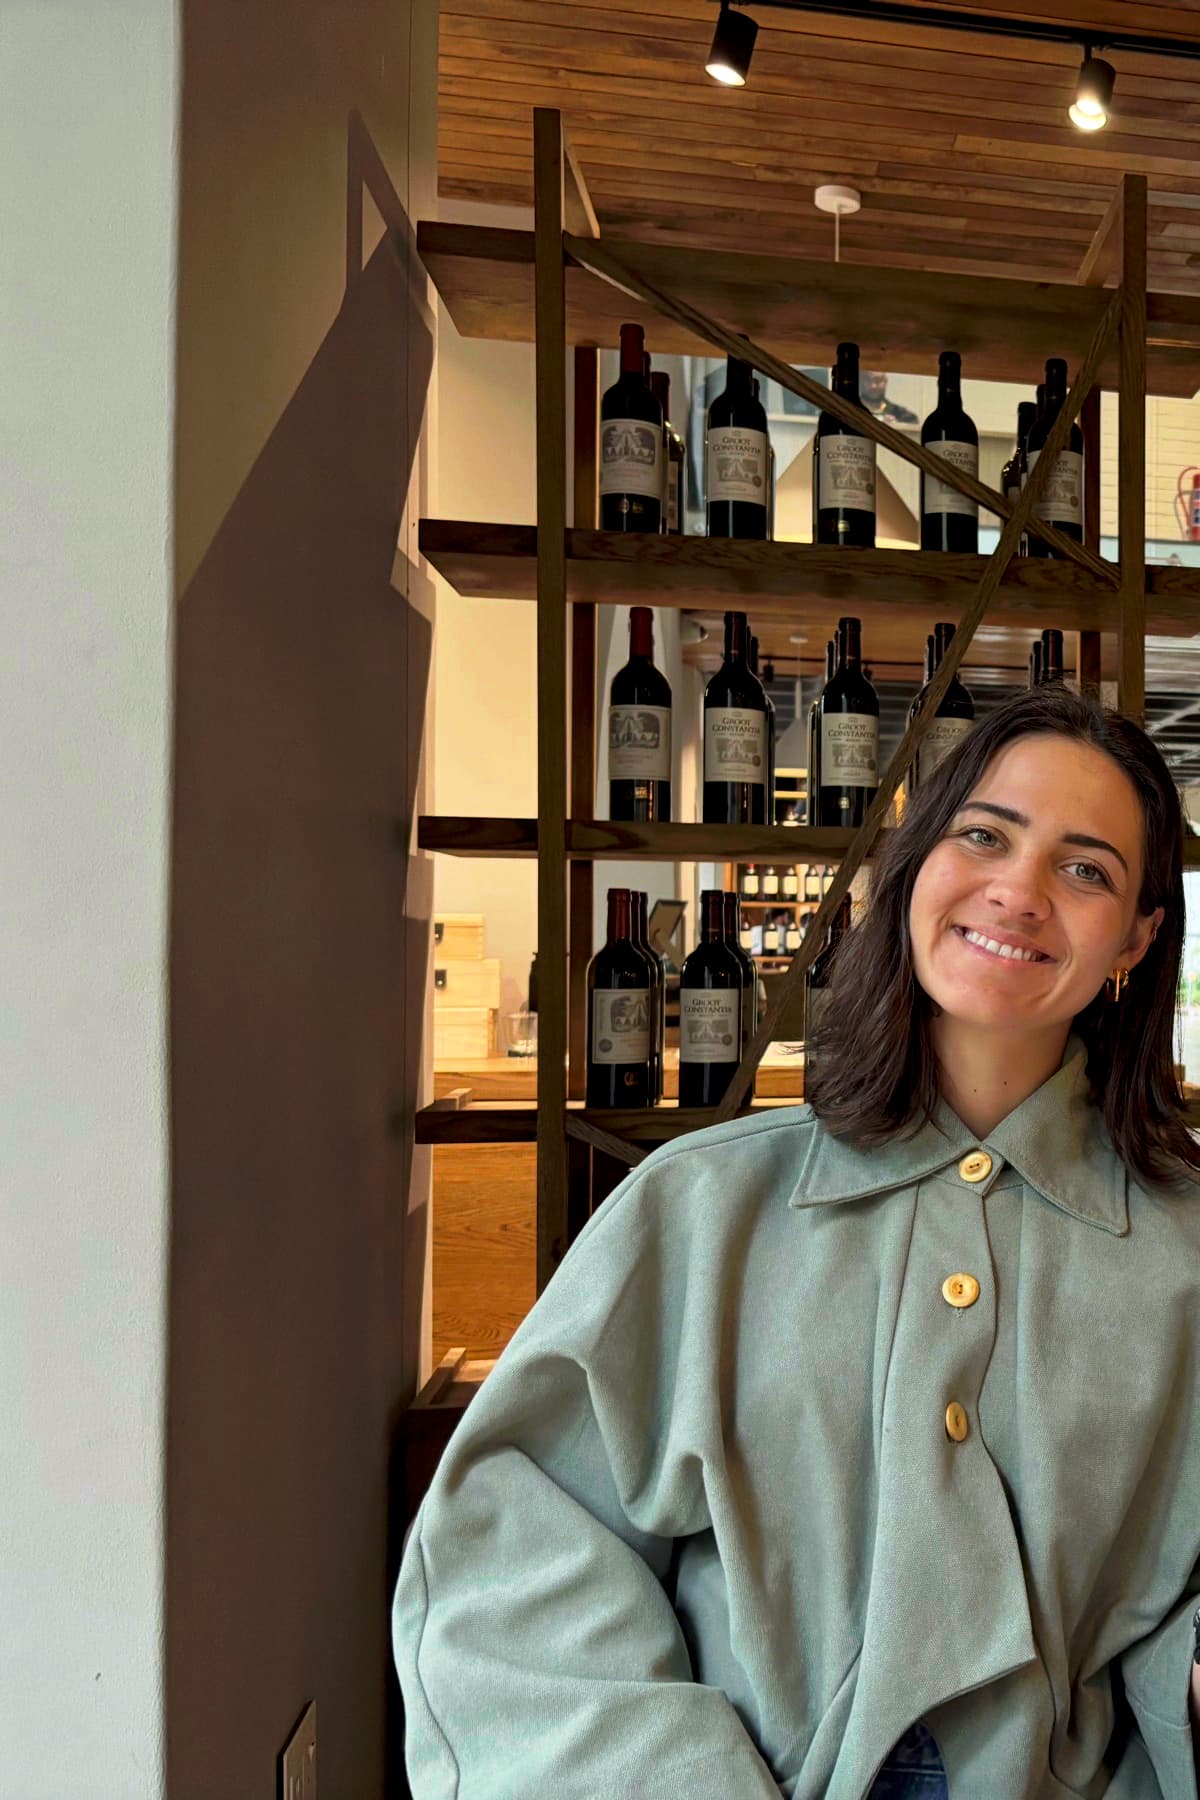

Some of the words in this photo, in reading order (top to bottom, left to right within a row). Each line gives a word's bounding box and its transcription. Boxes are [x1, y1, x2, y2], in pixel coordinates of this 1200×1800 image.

[722, 436, 752, 446] GROOT
[712, 444, 761, 459] CONSTANTIA
[836, 445, 865, 454] GROOT
[722, 717, 752, 727] GROOT
[838, 722, 867, 731] GROOT
[711, 723, 761, 735] CONSTANTIA
[692, 998, 720, 1007] GROOT
[683, 1005, 732, 1014] CONSTANTIA
